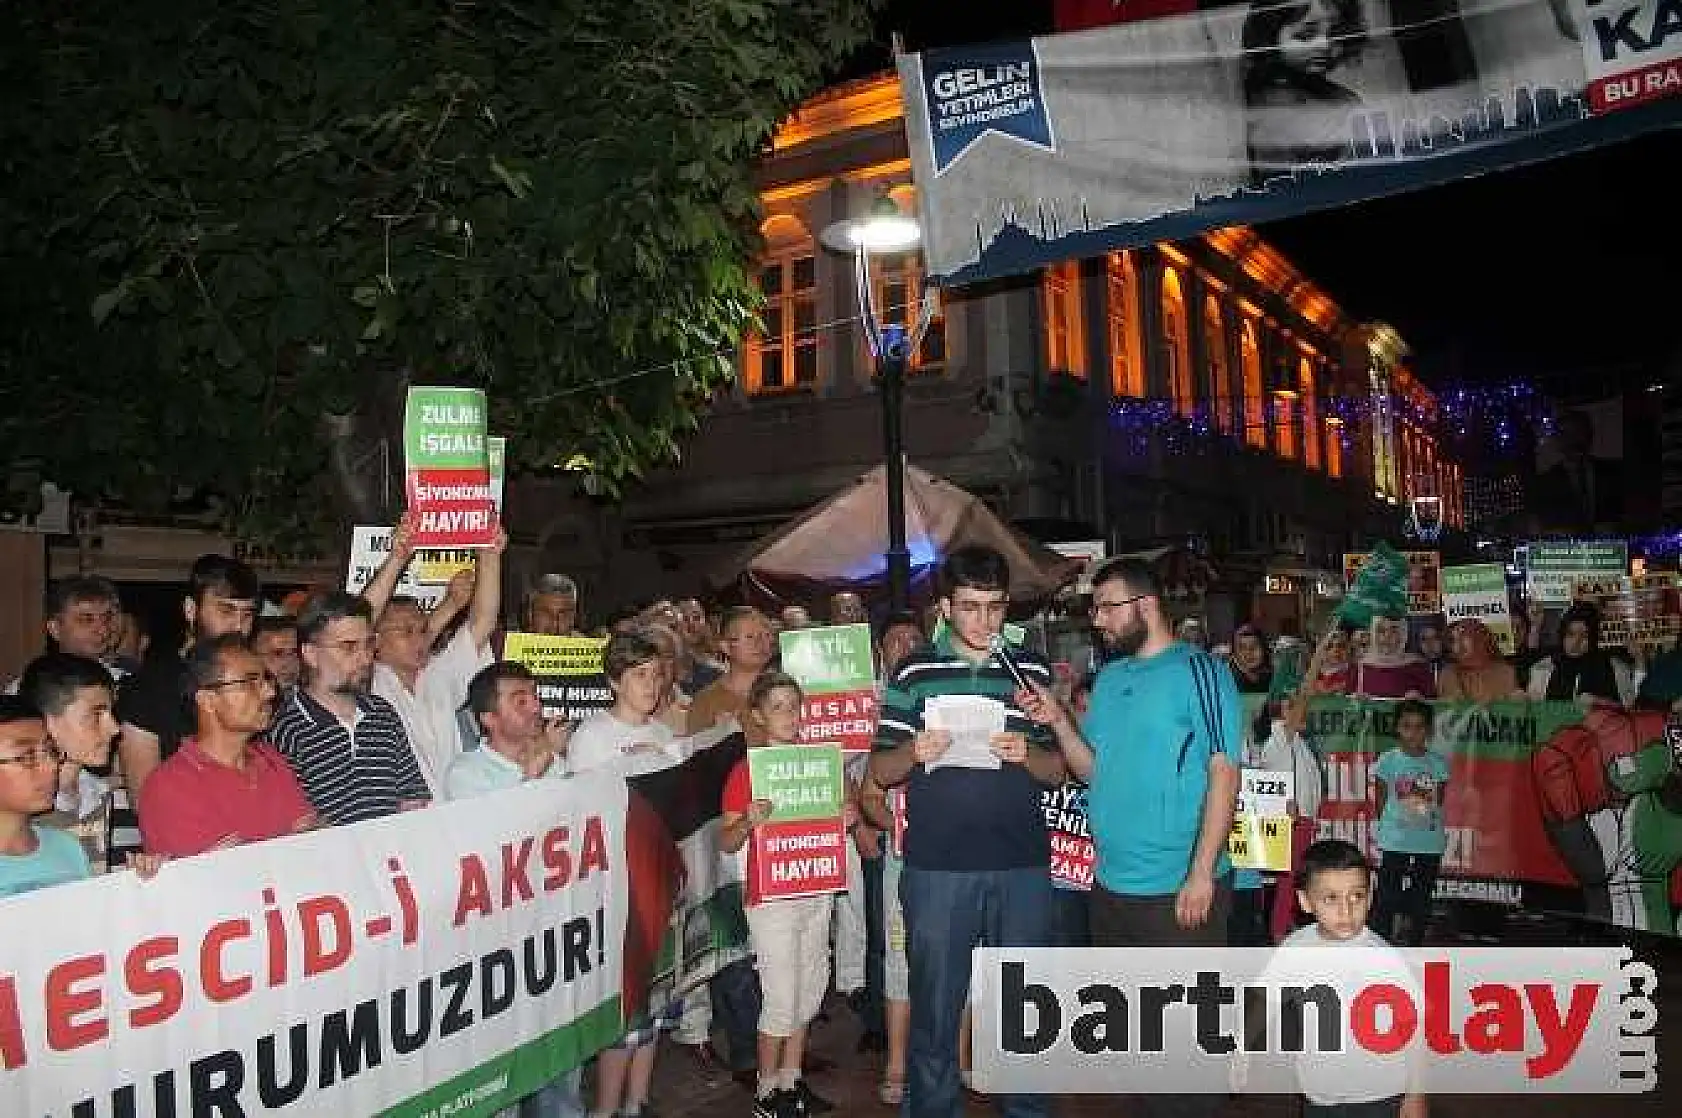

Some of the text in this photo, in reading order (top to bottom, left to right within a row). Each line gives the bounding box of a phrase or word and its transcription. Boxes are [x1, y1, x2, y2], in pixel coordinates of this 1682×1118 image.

[1604, 78, 1639, 102] BU
[420, 509, 488, 533] HAYIR!
[453, 815, 610, 928] AKSA
[771, 856, 838, 881] HAYIR!
